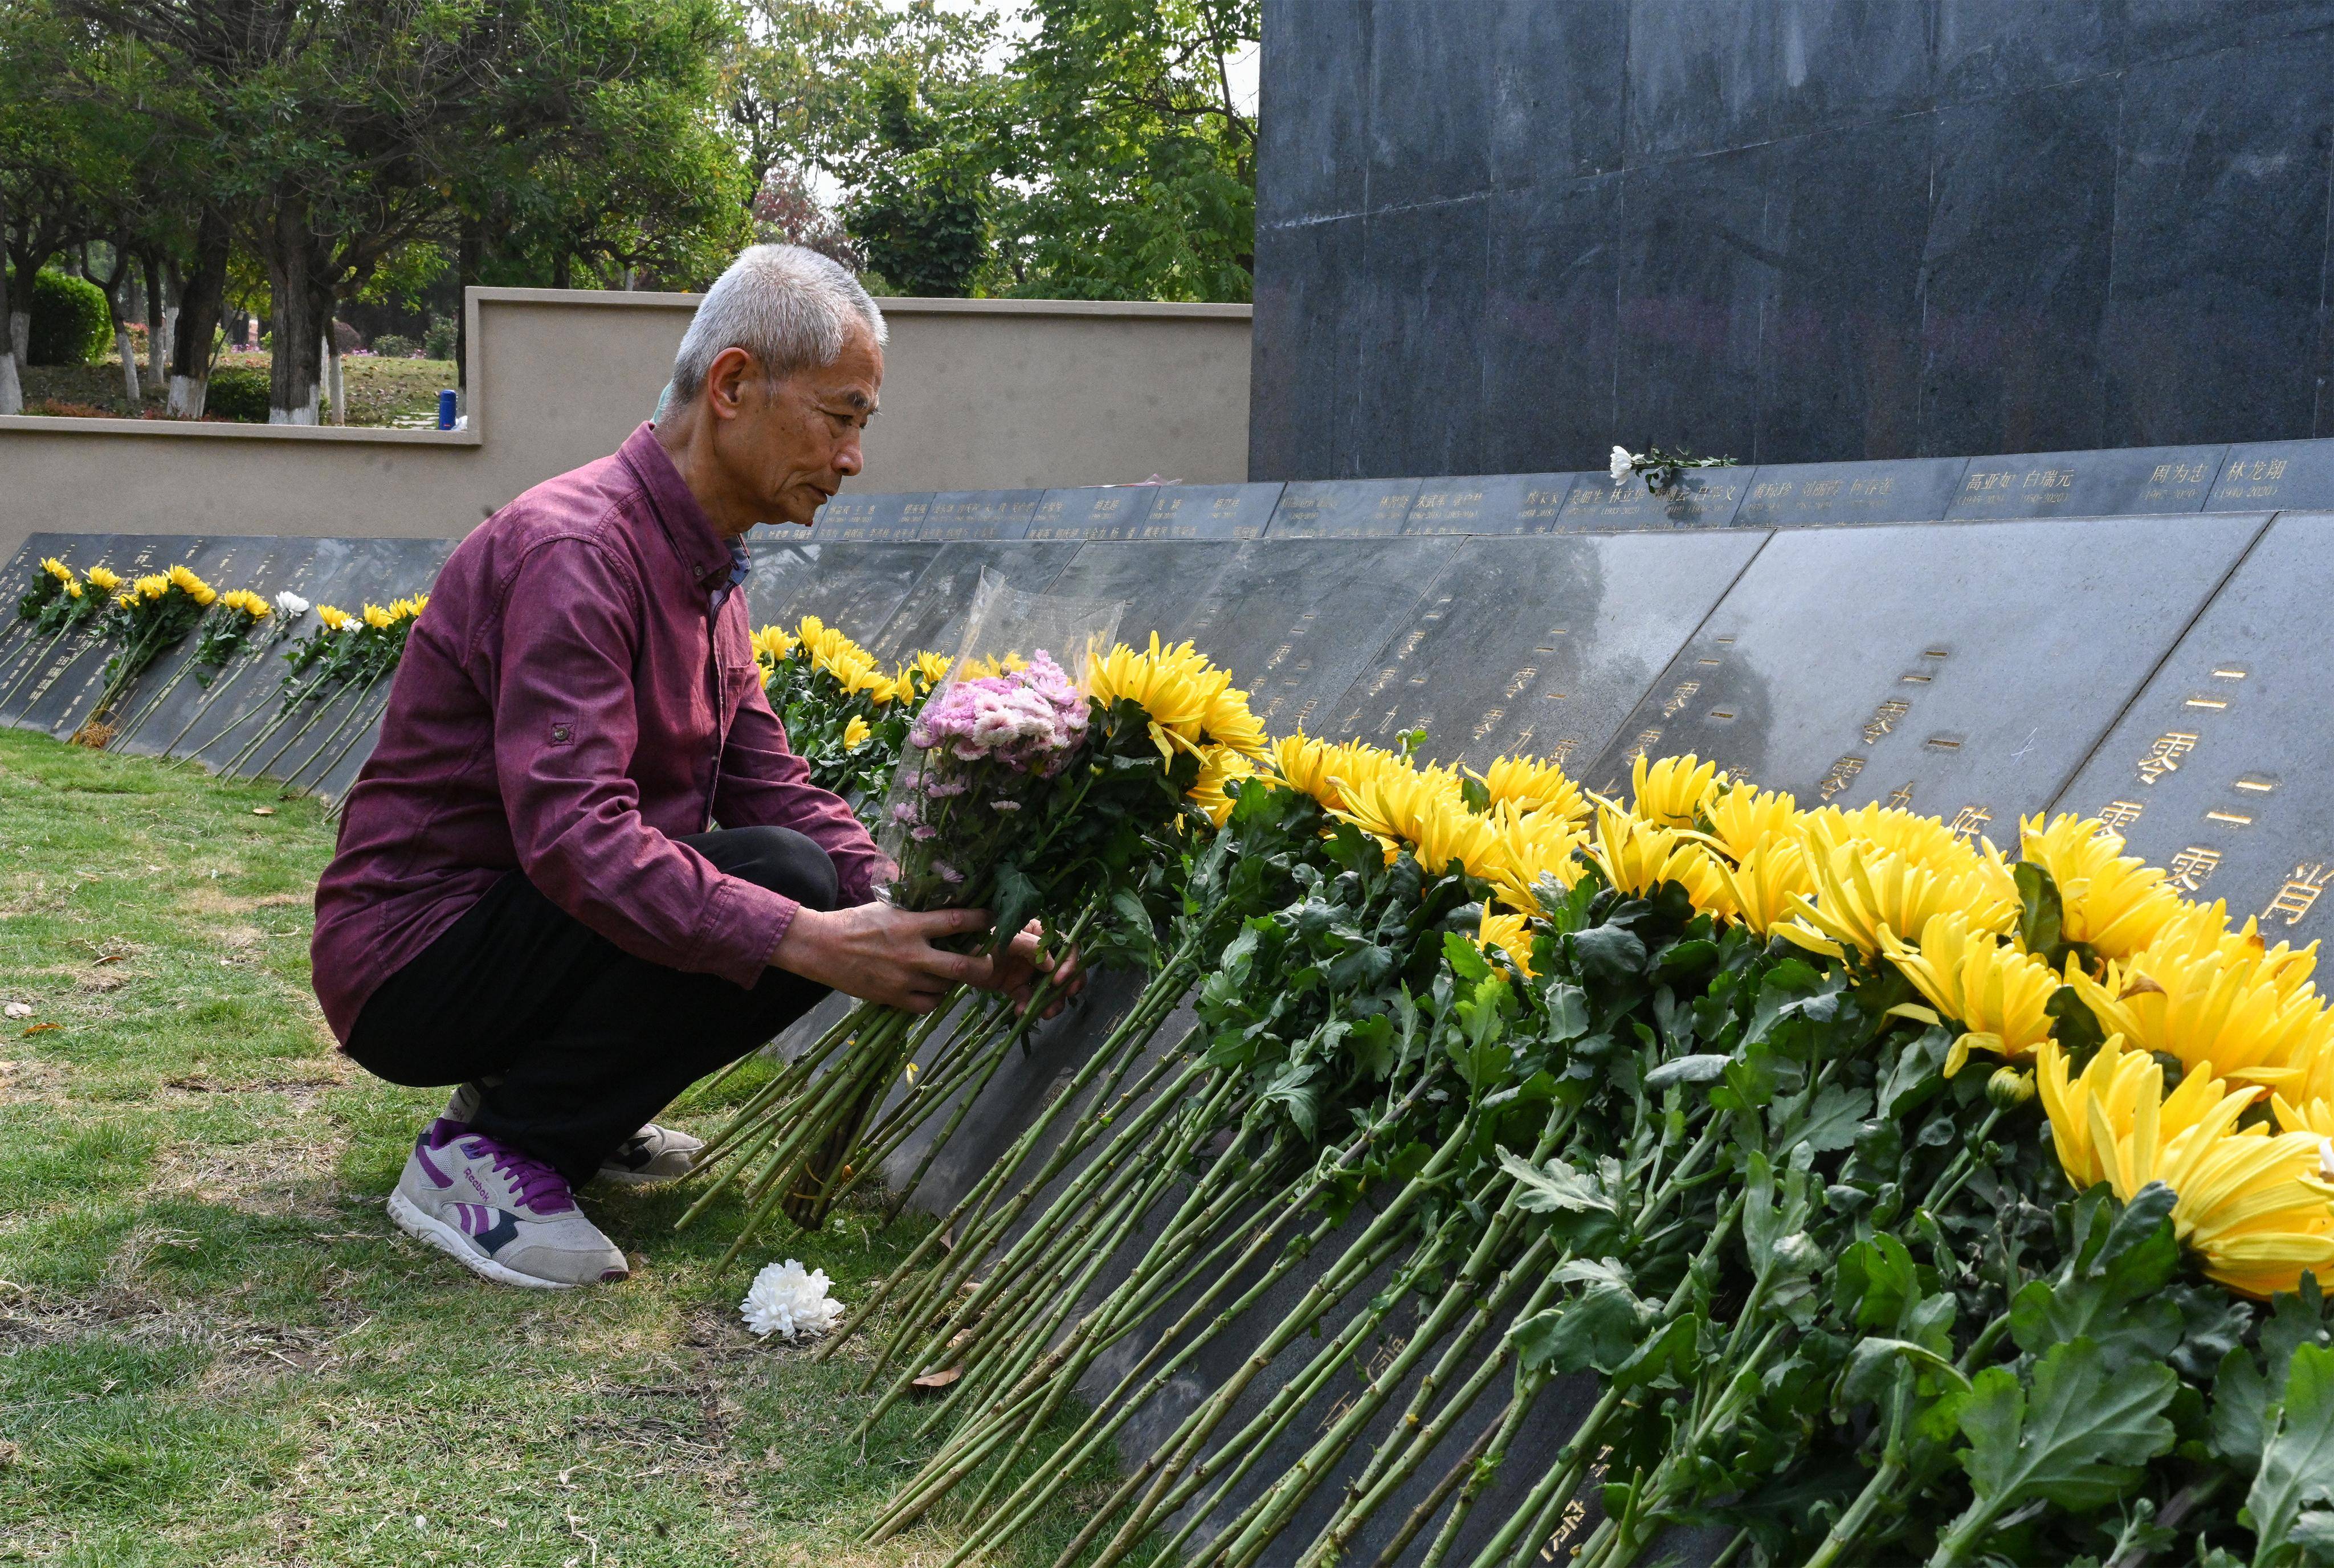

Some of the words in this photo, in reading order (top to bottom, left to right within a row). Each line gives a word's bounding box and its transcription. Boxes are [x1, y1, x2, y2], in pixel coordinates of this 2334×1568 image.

[2023, 469, 2074, 488] 白瑞元
[2148, 463, 2209, 484] 周为忠
[2227, 459, 2287, 481] 林龙翔
[1609, 488, 1646, 503] 林立华
[1694, 486, 1737, 502] 吕学义
[1754, 482, 1792, 499] 黄琼珍
[2259, 864, 2334, 925] 肖
[464, 1168, 489, 1202] Reebok
